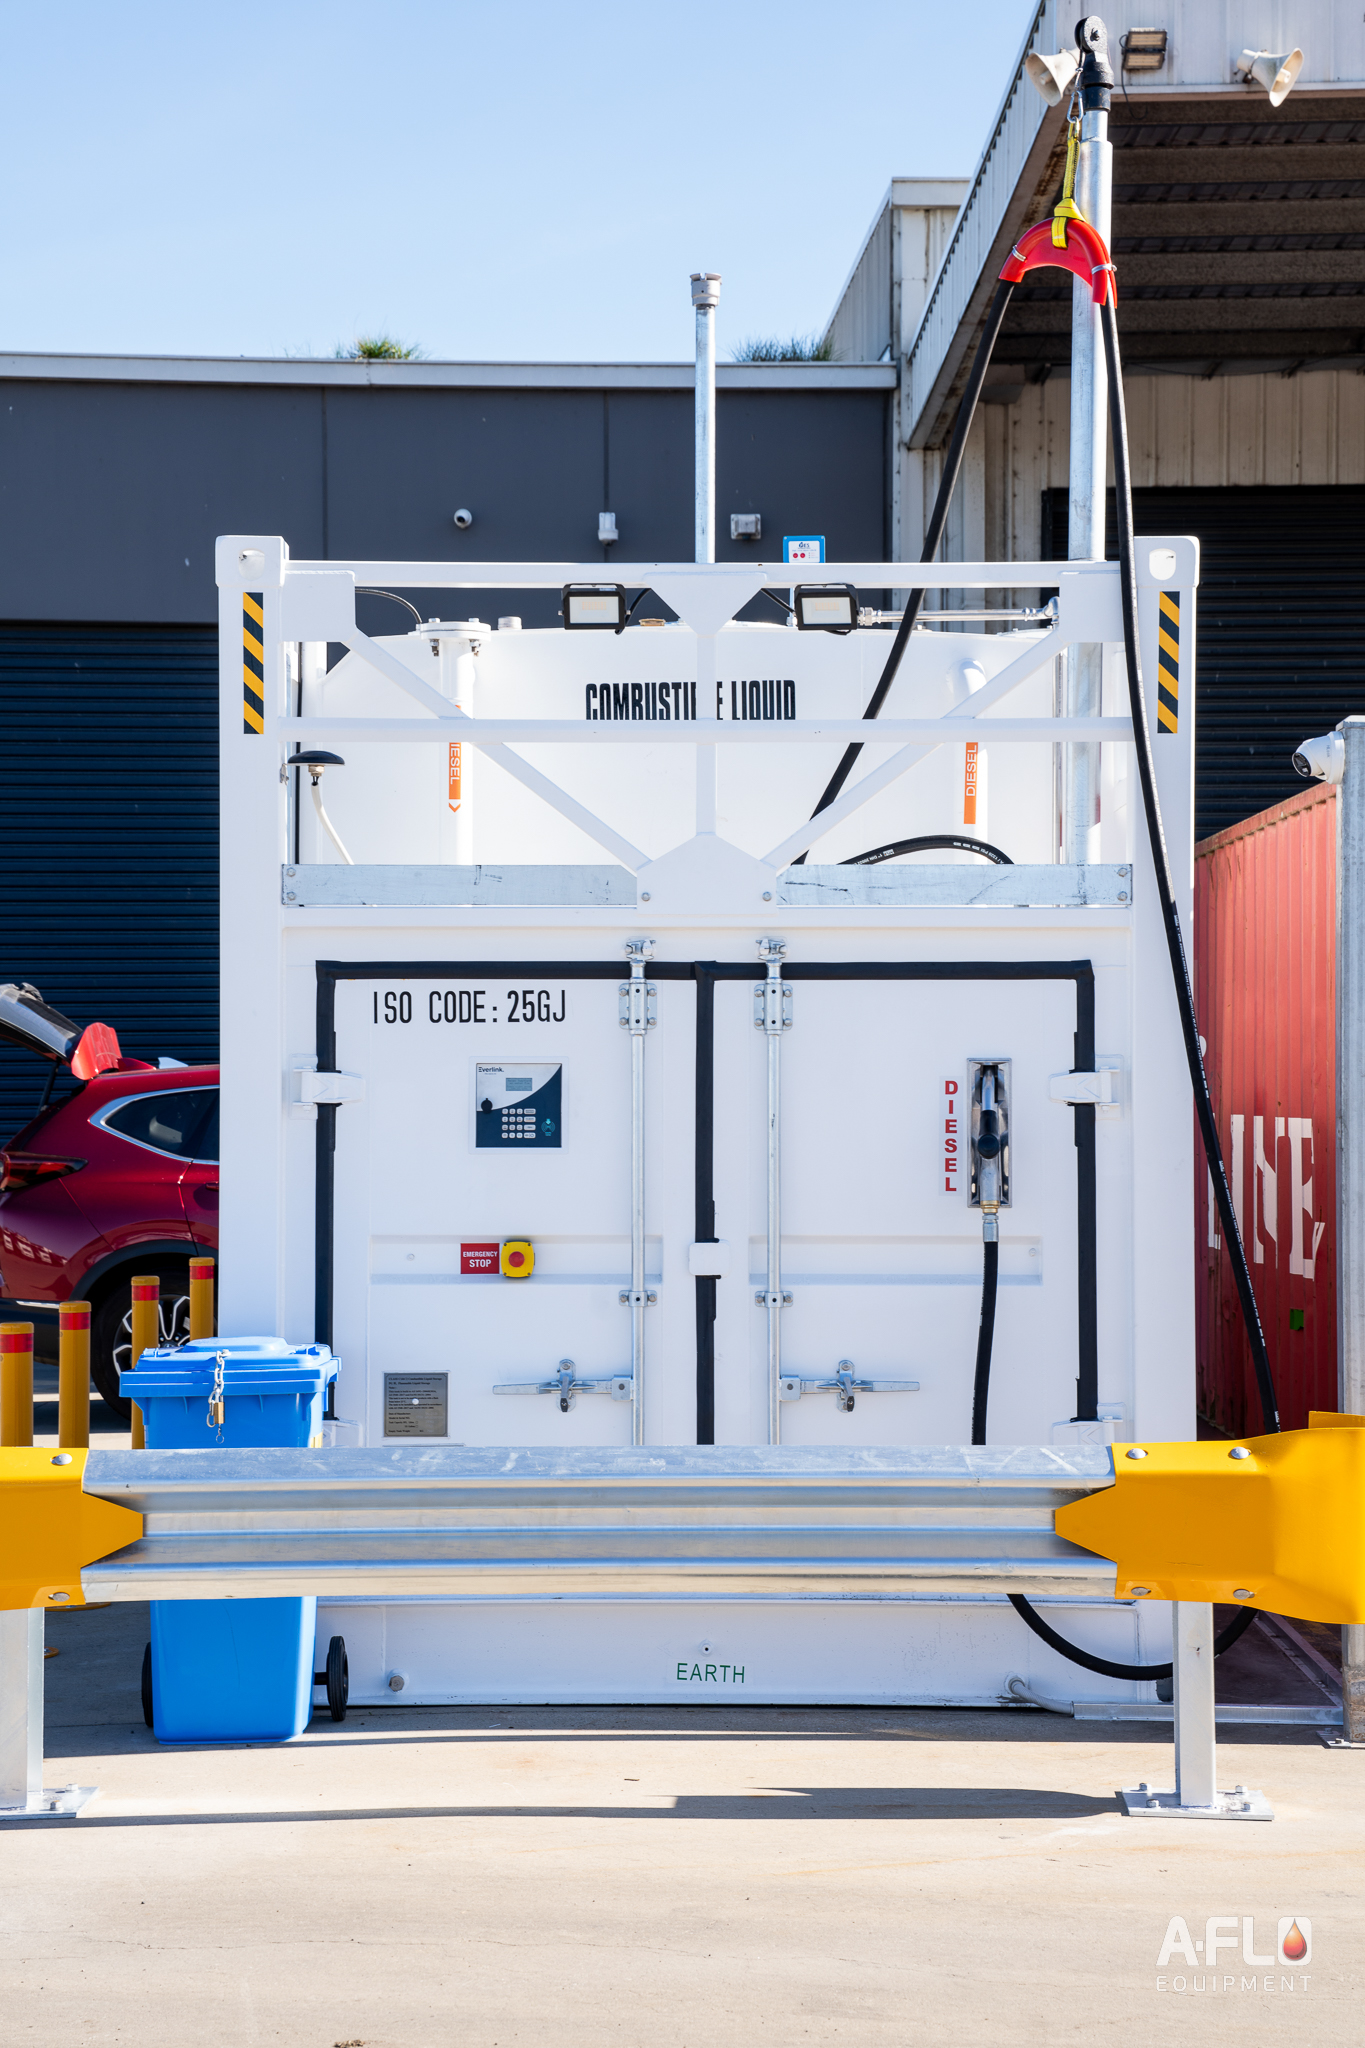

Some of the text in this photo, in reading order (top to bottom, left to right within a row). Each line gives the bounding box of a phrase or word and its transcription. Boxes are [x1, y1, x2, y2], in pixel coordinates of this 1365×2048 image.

[586, 681, 723, 720] COMBUSTIE
[450, 743, 460, 785] IESEL
[965, 744, 977, 797] DIESEL
[374, 990, 412, 1024] ISO
[507, 989, 566, 1023] 25GJ
[944, 1080, 958, 1192] DIESEL
[469, 1259, 492, 1268] STOP
[676, 1662, 745, 1684] EARTH
